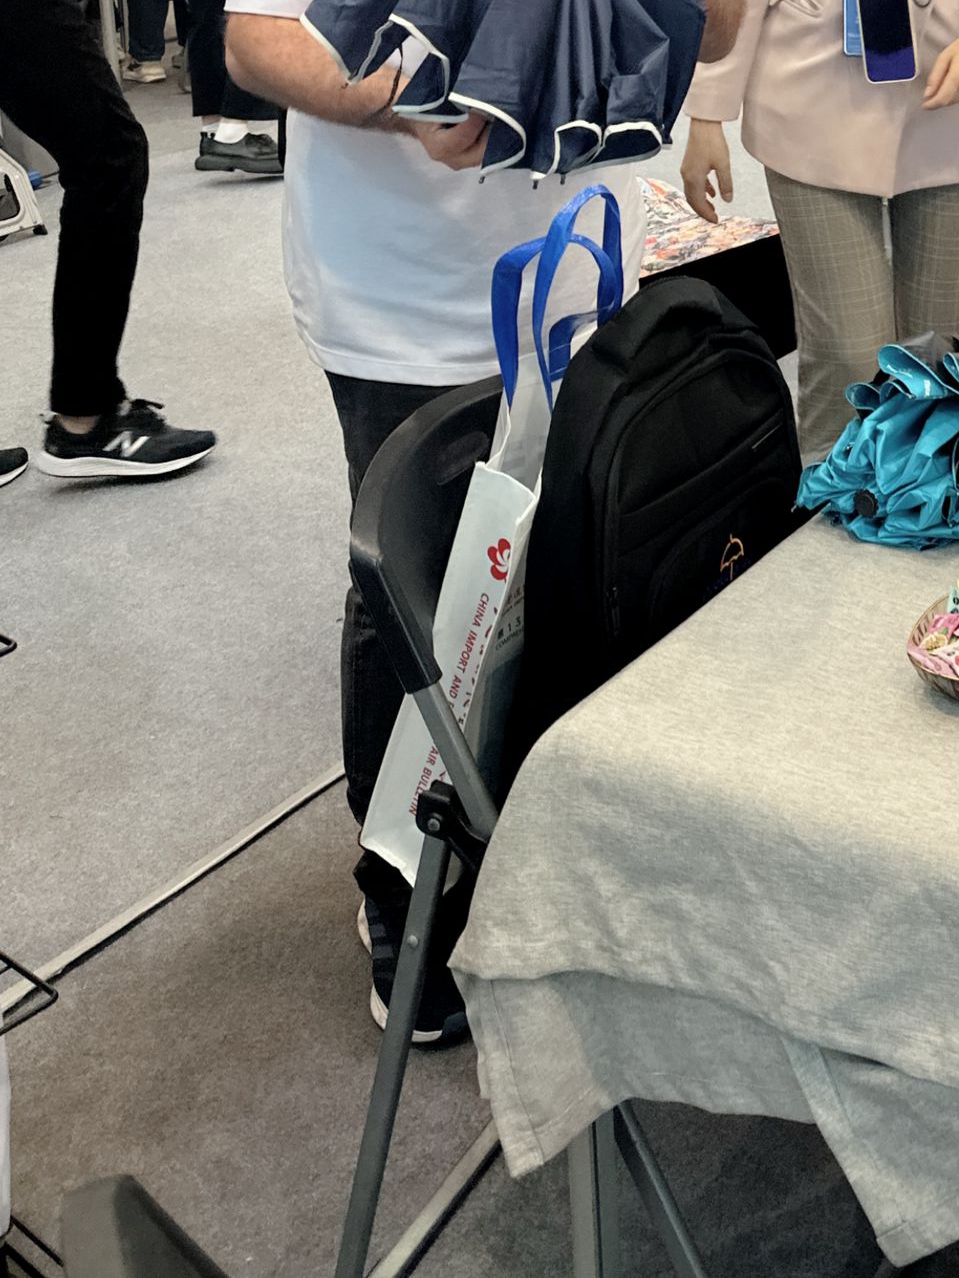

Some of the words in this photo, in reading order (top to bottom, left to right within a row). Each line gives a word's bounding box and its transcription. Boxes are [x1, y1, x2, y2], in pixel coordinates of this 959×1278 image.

[472, 593, 489, 627] CHINA
[457, 629, 478, 674] IMPORT
[449, 675, 462, 699] AND
[426, 746, 439, 766] AIR
